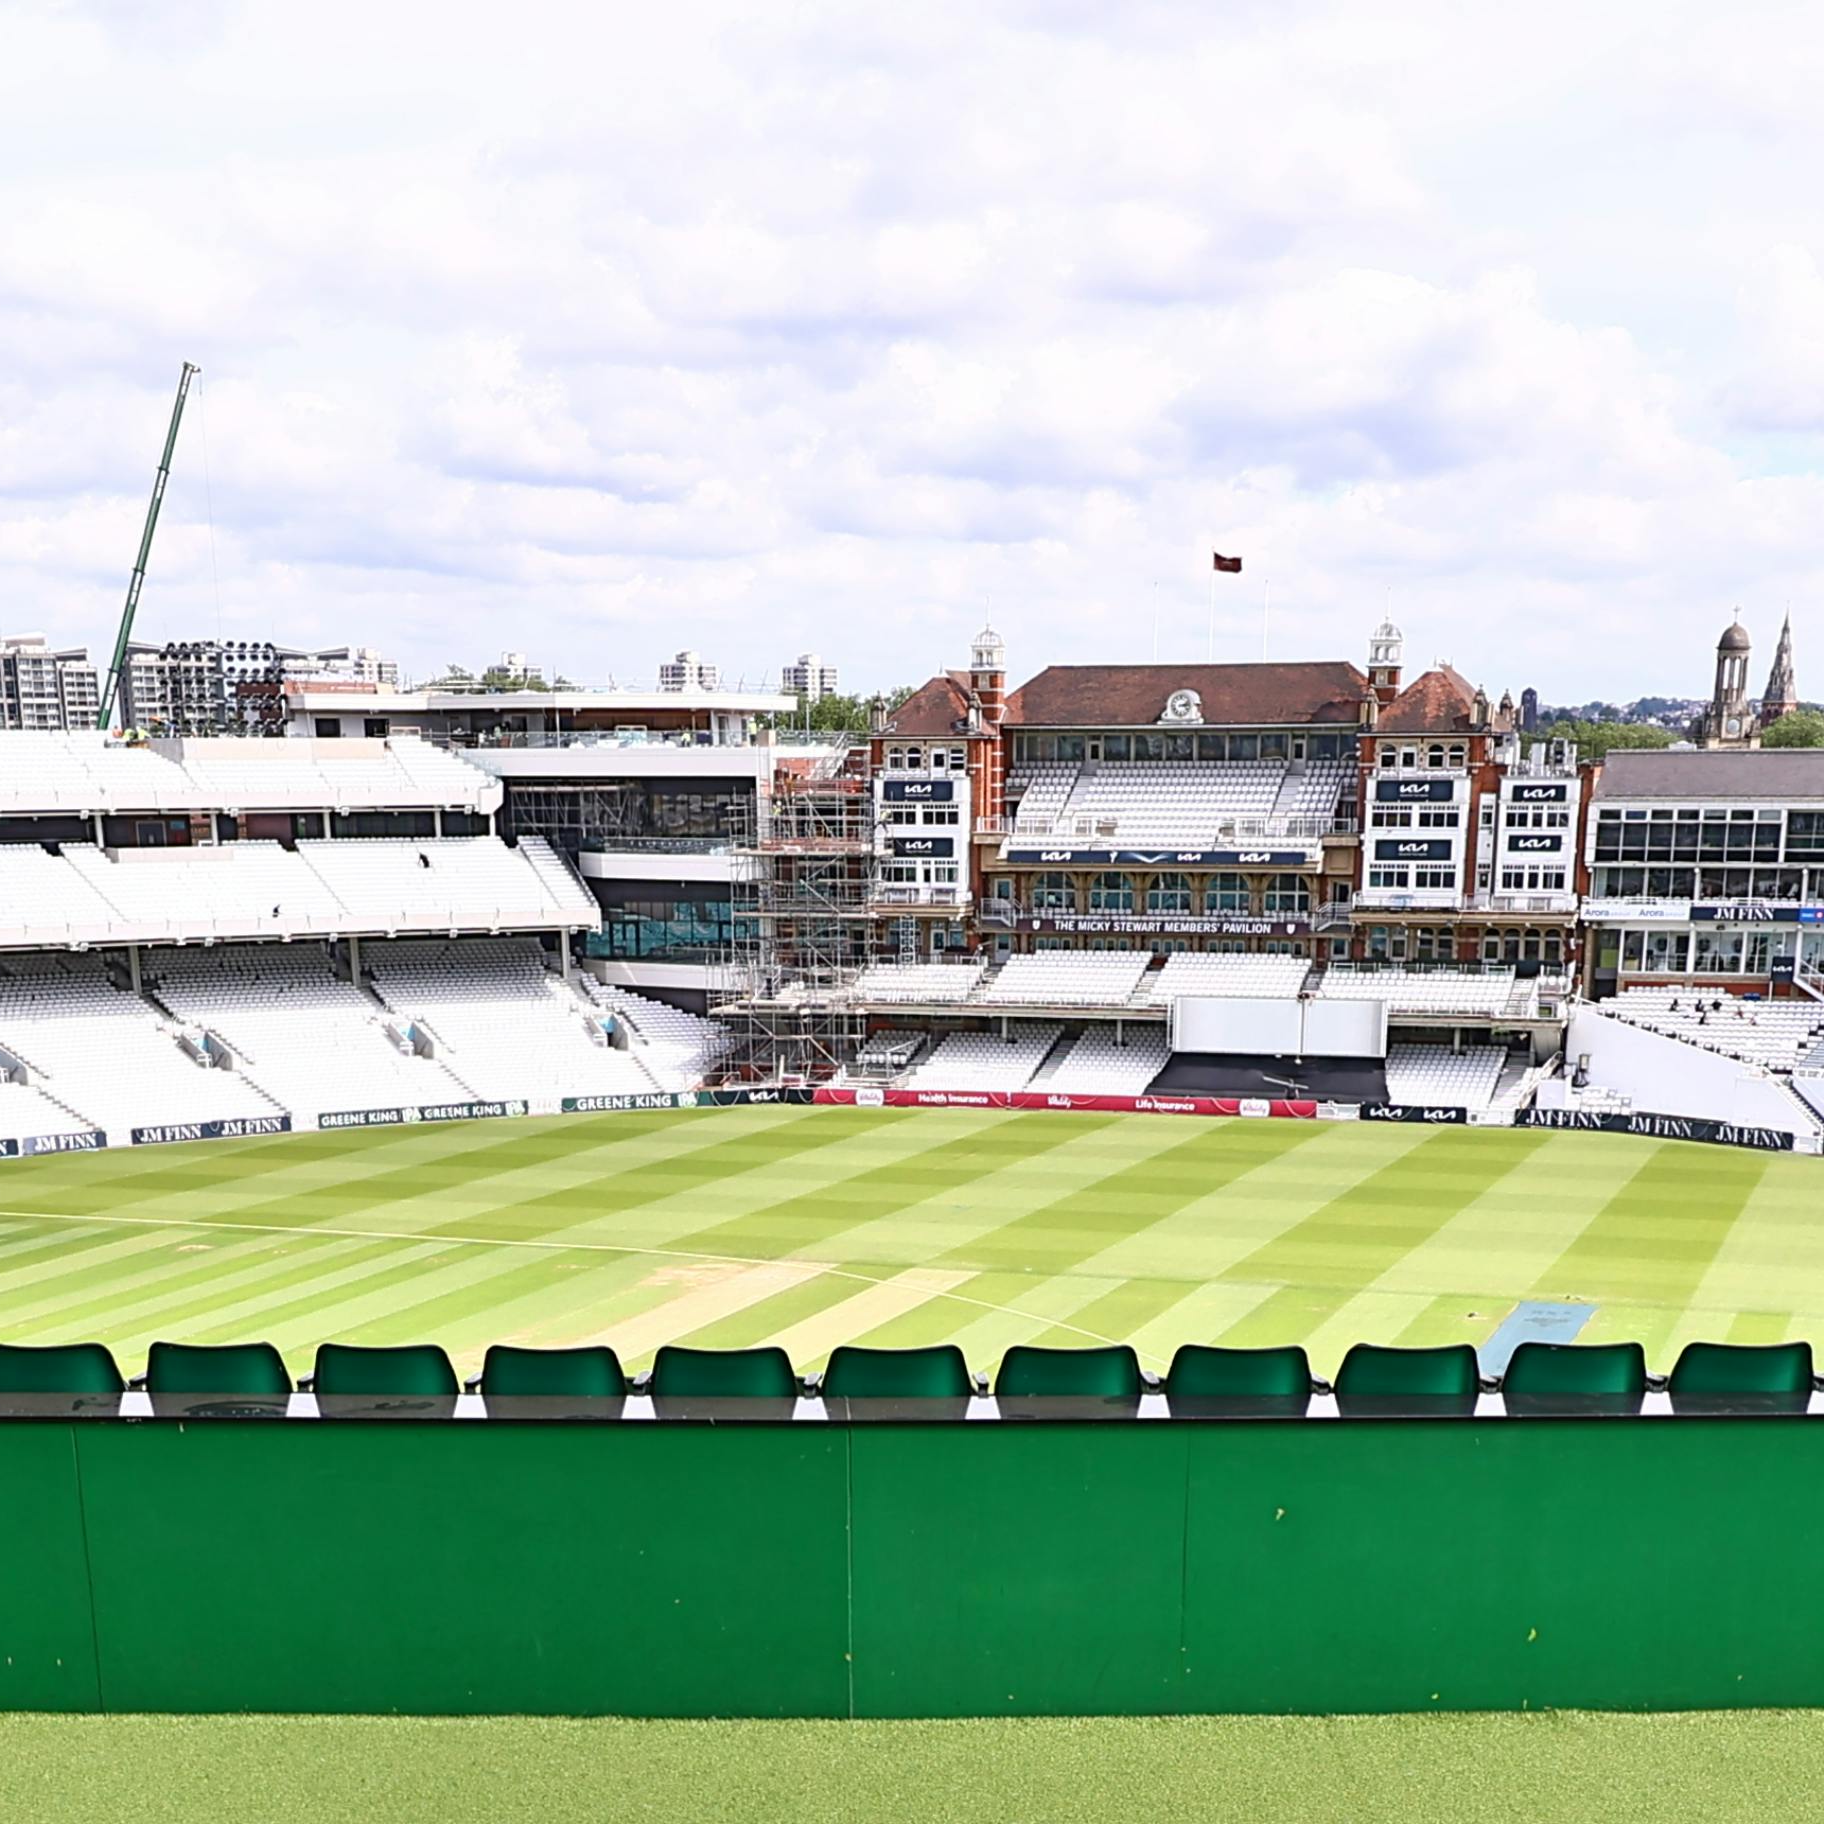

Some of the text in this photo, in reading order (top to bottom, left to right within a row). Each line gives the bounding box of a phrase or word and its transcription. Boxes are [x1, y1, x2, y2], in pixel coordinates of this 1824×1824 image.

[1585, 908, 1610, 917] Arora
[1638, 908, 1664, 917] Arora
[1713, 908, 1774, 920] JM FINN
[1054, 920, 1075, 931] THE
[1078, 920, 1110, 932] MICKY
[1113, 921, 1162, 933] STEWART
[1223, 923, 1271, 934] PAVILION
[577, 1097, 630, 1111] GREENE
[635, 1094, 672, 1108] KING
[918, 1093, 947, 1104] Health
[1135, 1099, 1152, 1109] Life
[321, 1111, 366, 1126] GREENE
[368, 1110, 399, 1123] KING
[424, 1105, 469, 1119] GREENE
[472, 1103, 502, 1117] KING
[1526, 1109, 1603, 1129] JM FINN
[141, 1124, 201, 1142] JM FINN
[222, 1118, 282, 1136] JM FINN
[1628, 1116, 1692, 1137] JM FINN
[34, 1133, 96, 1152] JM FINN
[1715, 1125, 1783, 1147] JM FINN
